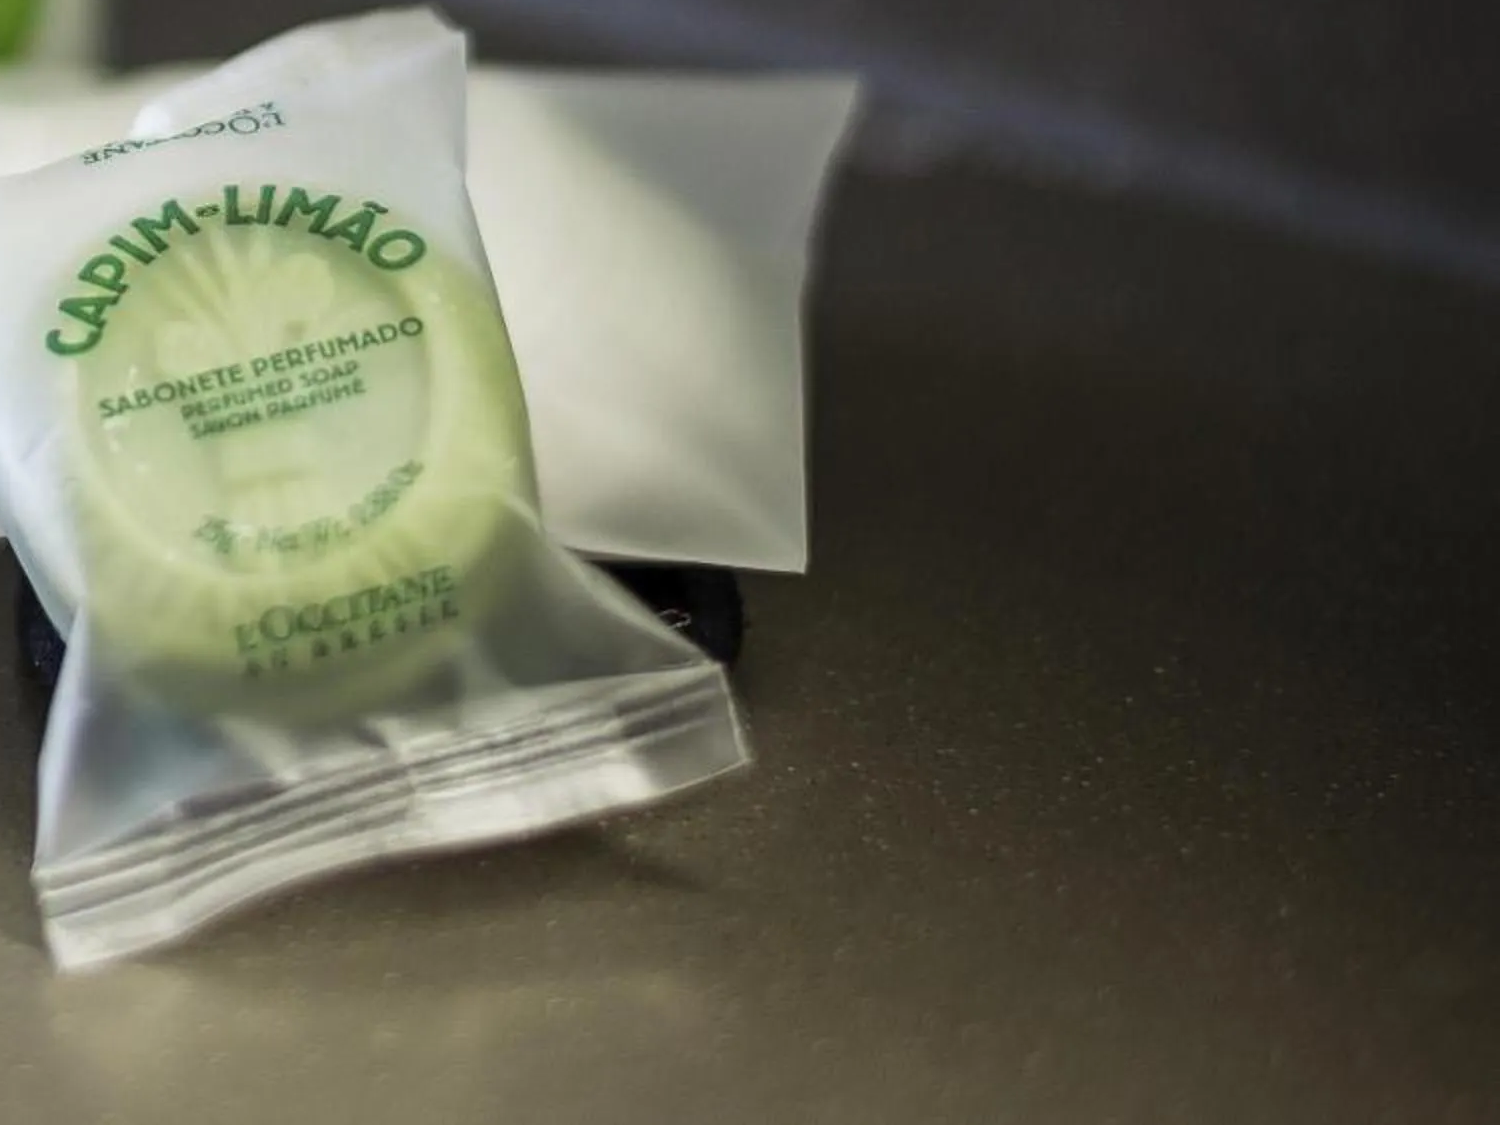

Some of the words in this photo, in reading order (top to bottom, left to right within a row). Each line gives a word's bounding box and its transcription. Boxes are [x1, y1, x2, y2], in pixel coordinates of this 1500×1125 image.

[45, 183, 427, 357] CAPIM-LIMÃO
[98, 363, 245, 419] SABONETE
[249, 315, 424, 378] PERFUMADO
[180, 377, 293, 422] PERFUMED
[298, 359, 360, 389] SOAP
